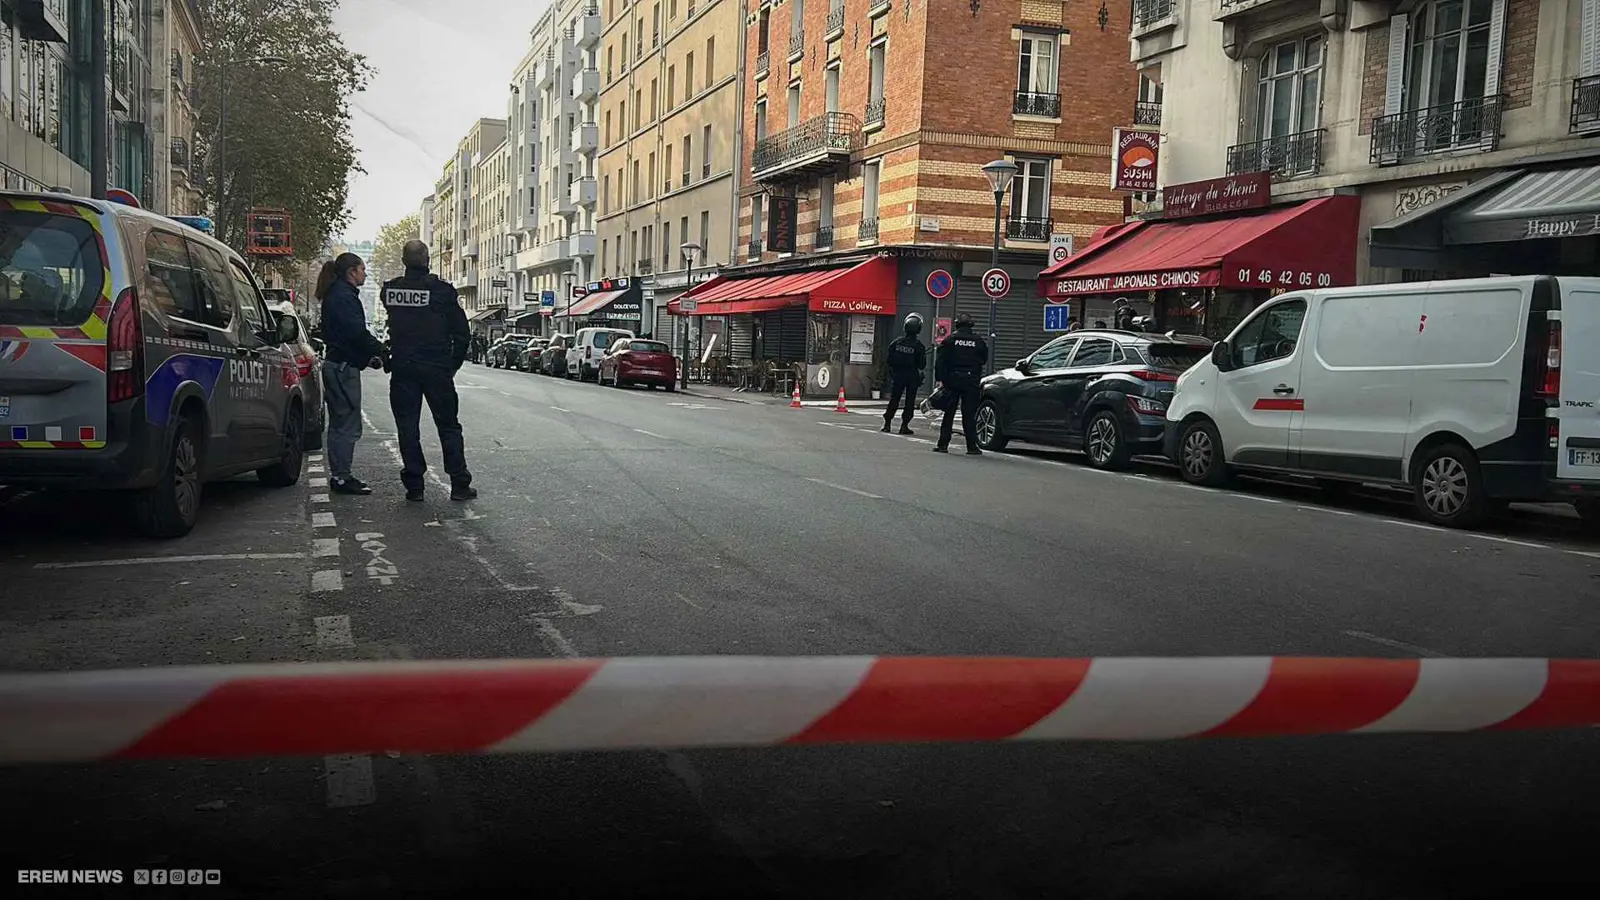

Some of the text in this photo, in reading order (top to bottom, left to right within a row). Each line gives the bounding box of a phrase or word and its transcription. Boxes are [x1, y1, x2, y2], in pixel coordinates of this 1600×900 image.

[1120, 132, 1158, 149] RESTAURANT
[1123, 168, 1152, 180] SUSHI
[1166, 188, 1203, 209] Auberge
[1206, 184, 1218, 200] du
[1223, 180, 1258, 198] Phenix
[1527, 219, 1580, 236] Happy
[1056, 250, 1066, 259] 30
[989, 277, 1004, 289] 30
[1057, 271, 1200, 293] RESTAURANT JAPONAIS CHINOIS
[1239, 269, 1330, 286] 01 46 42 05 00
[389, 291, 427, 304] POLICE
[824, 301, 882, 311] PIZZA L'olivier
[230, 359, 264, 384] POLICE
